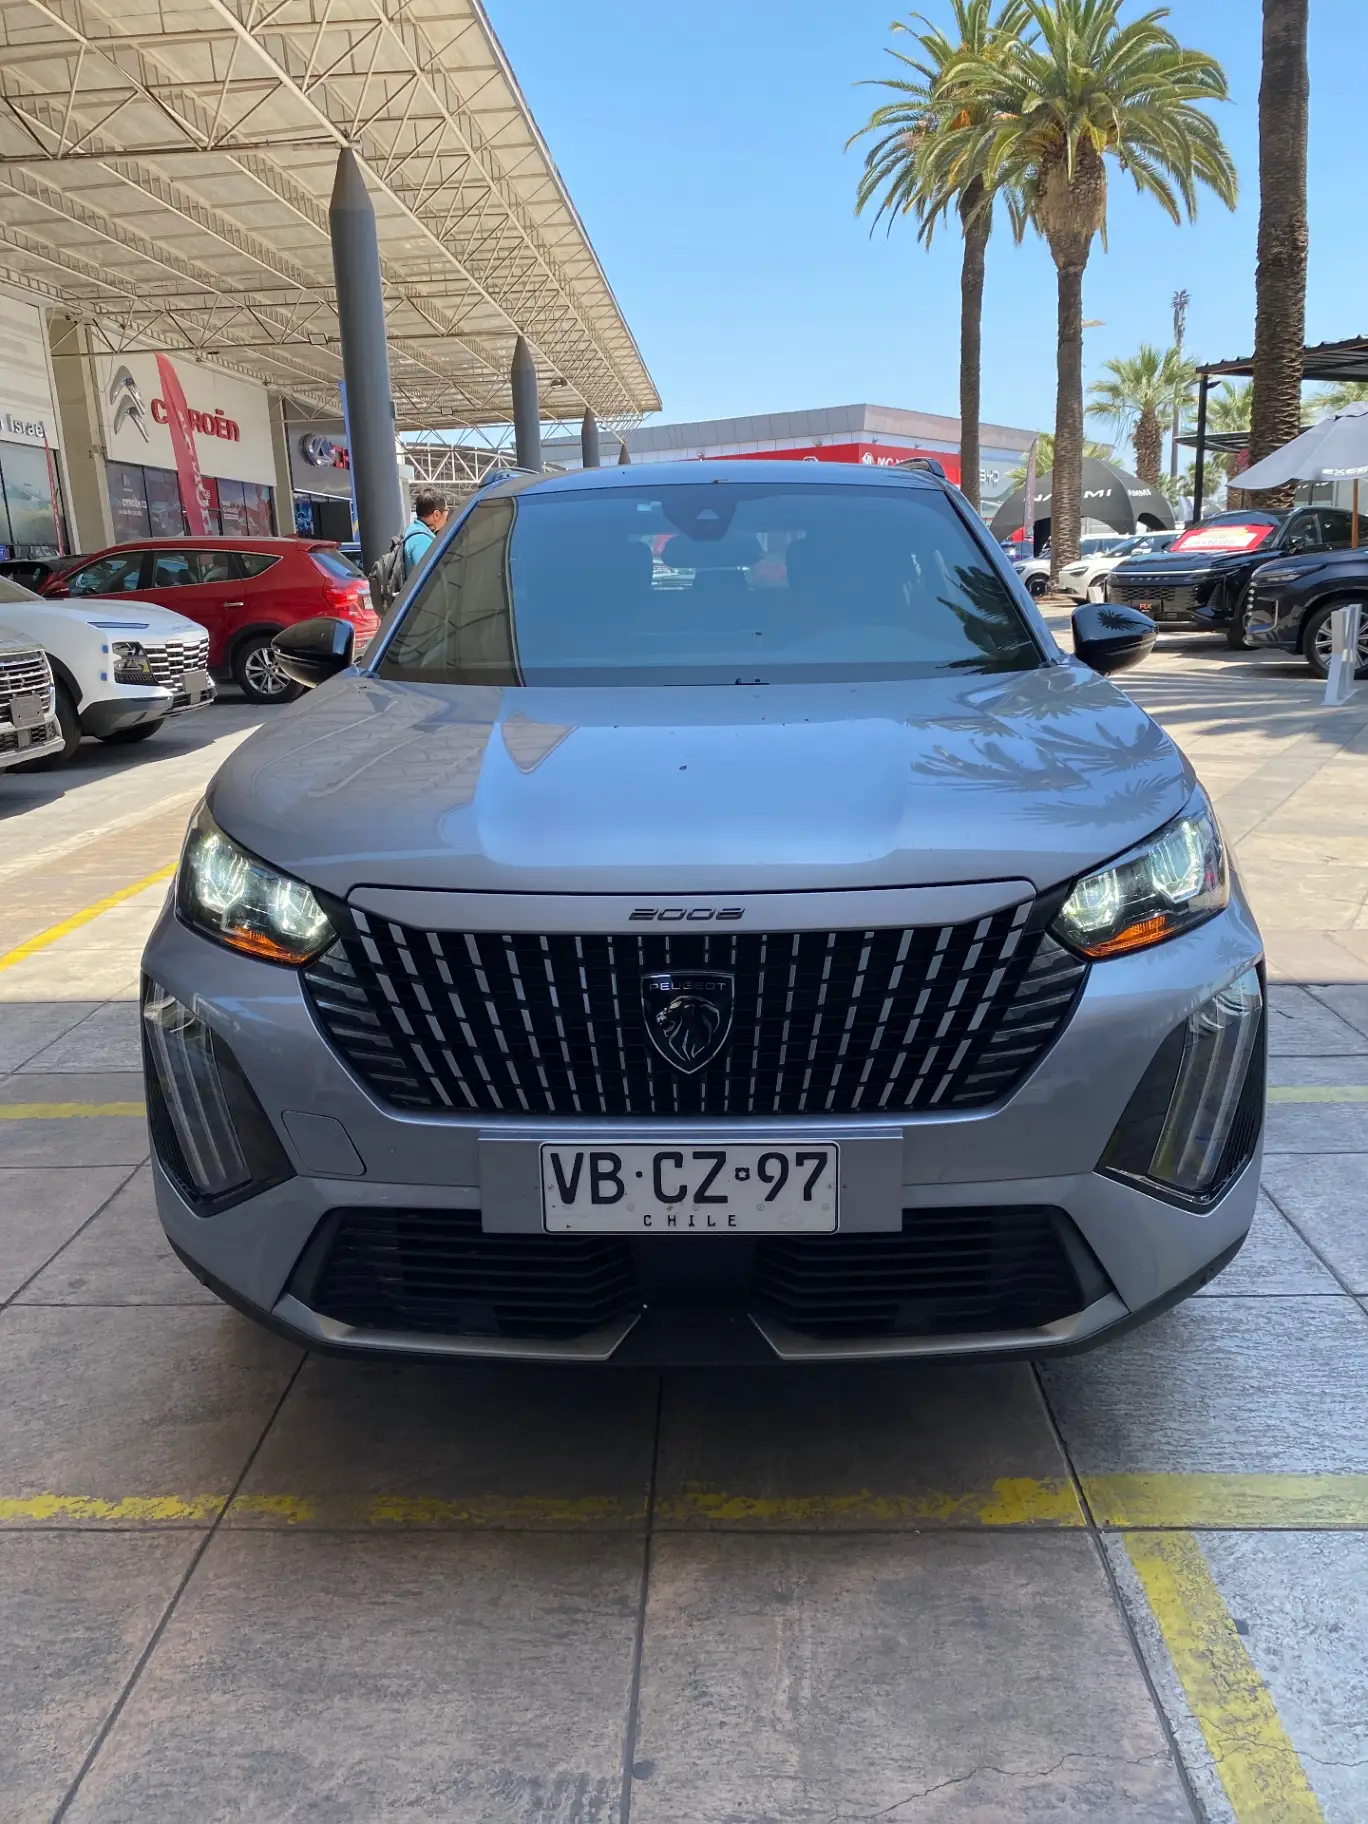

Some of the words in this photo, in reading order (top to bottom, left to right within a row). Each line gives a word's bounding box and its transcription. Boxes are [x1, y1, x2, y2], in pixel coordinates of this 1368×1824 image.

[151, 398, 240, 442] CROËN
[980, 469, 1000, 484] BYD
[628, 908, 745, 921] 2008
[649, 982, 726, 991] PEUGEOT
[643, 1214, 738, 1227] CHILE
